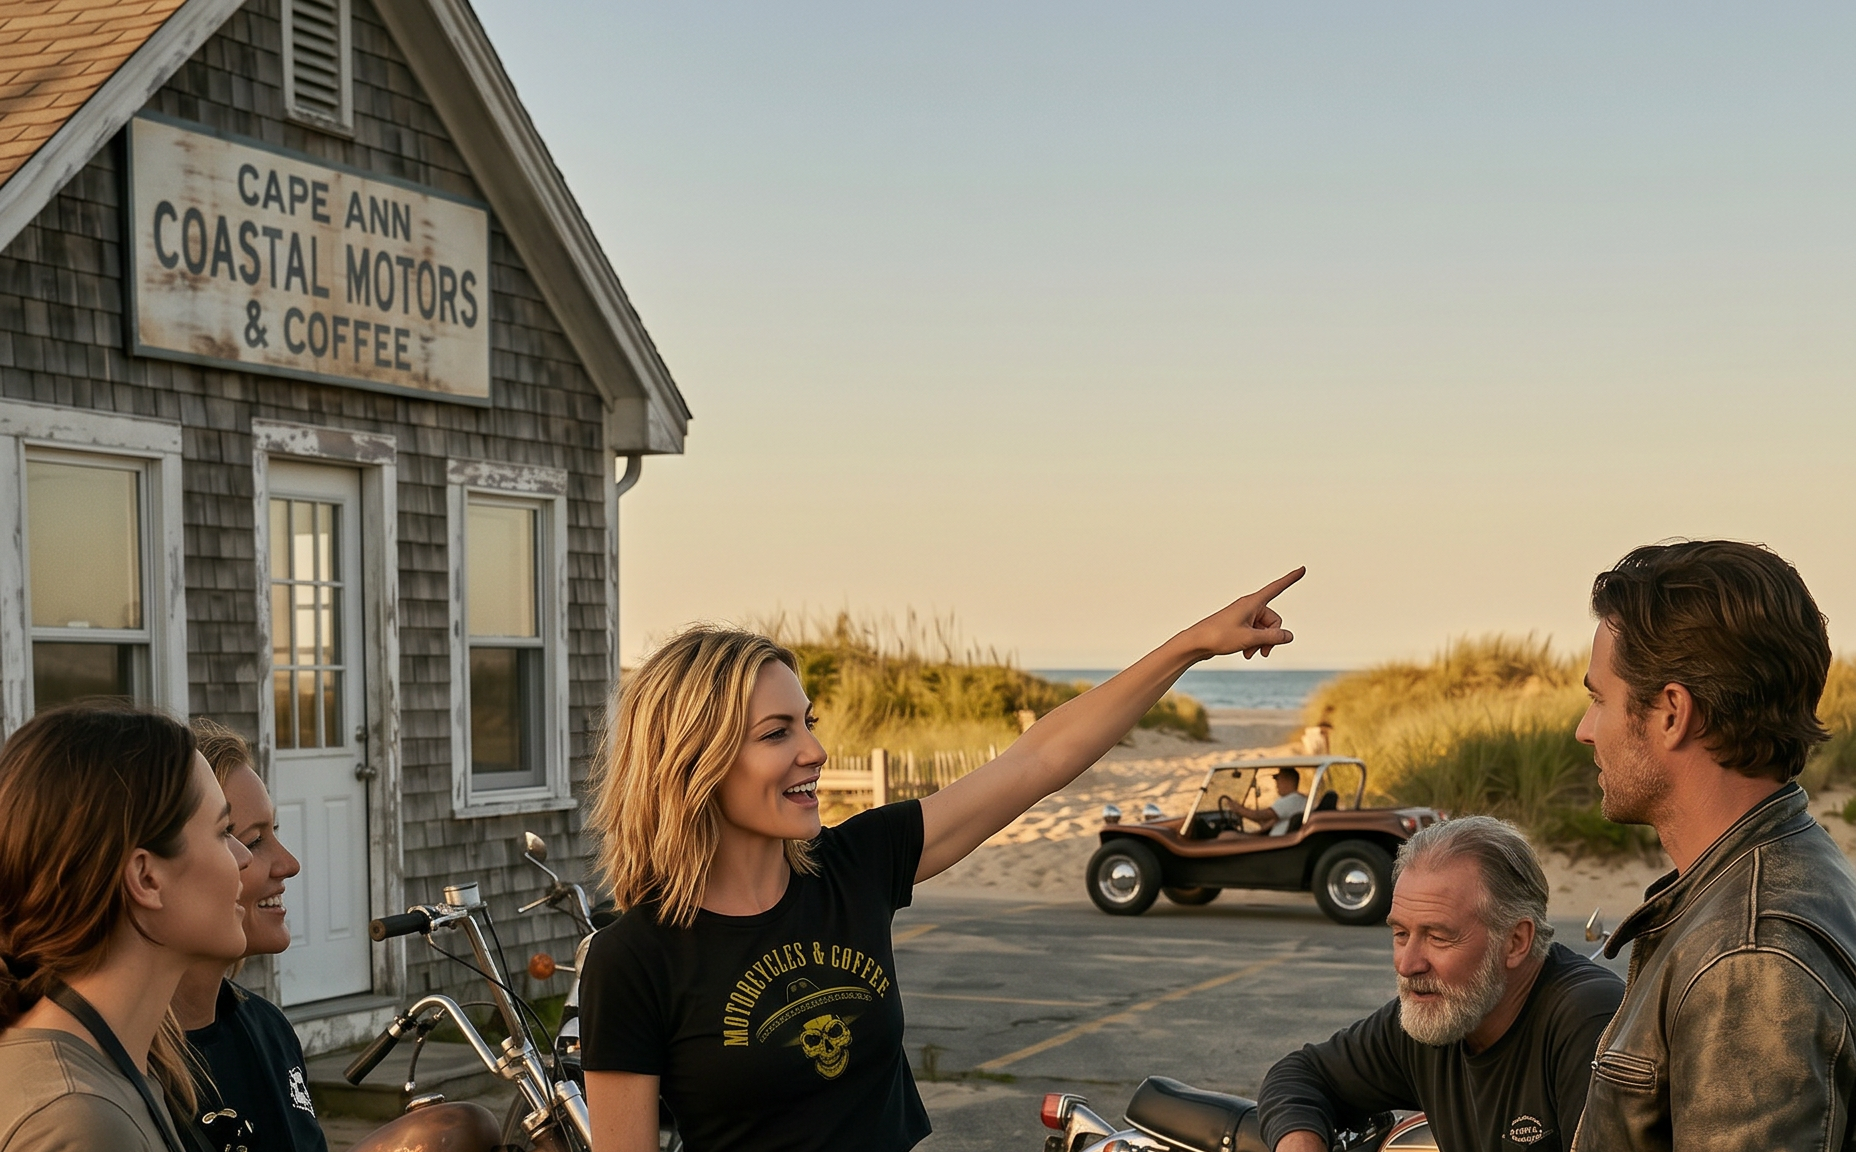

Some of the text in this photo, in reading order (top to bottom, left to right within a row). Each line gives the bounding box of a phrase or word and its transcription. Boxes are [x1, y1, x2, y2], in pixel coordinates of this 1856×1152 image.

[237, 163, 412, 243] CAPE ANN
[153, 200, 479, 328] COASTAL MOTORS
[244, 299, 412, 372] & COFFEE
[812, 941, 825, 965] &
